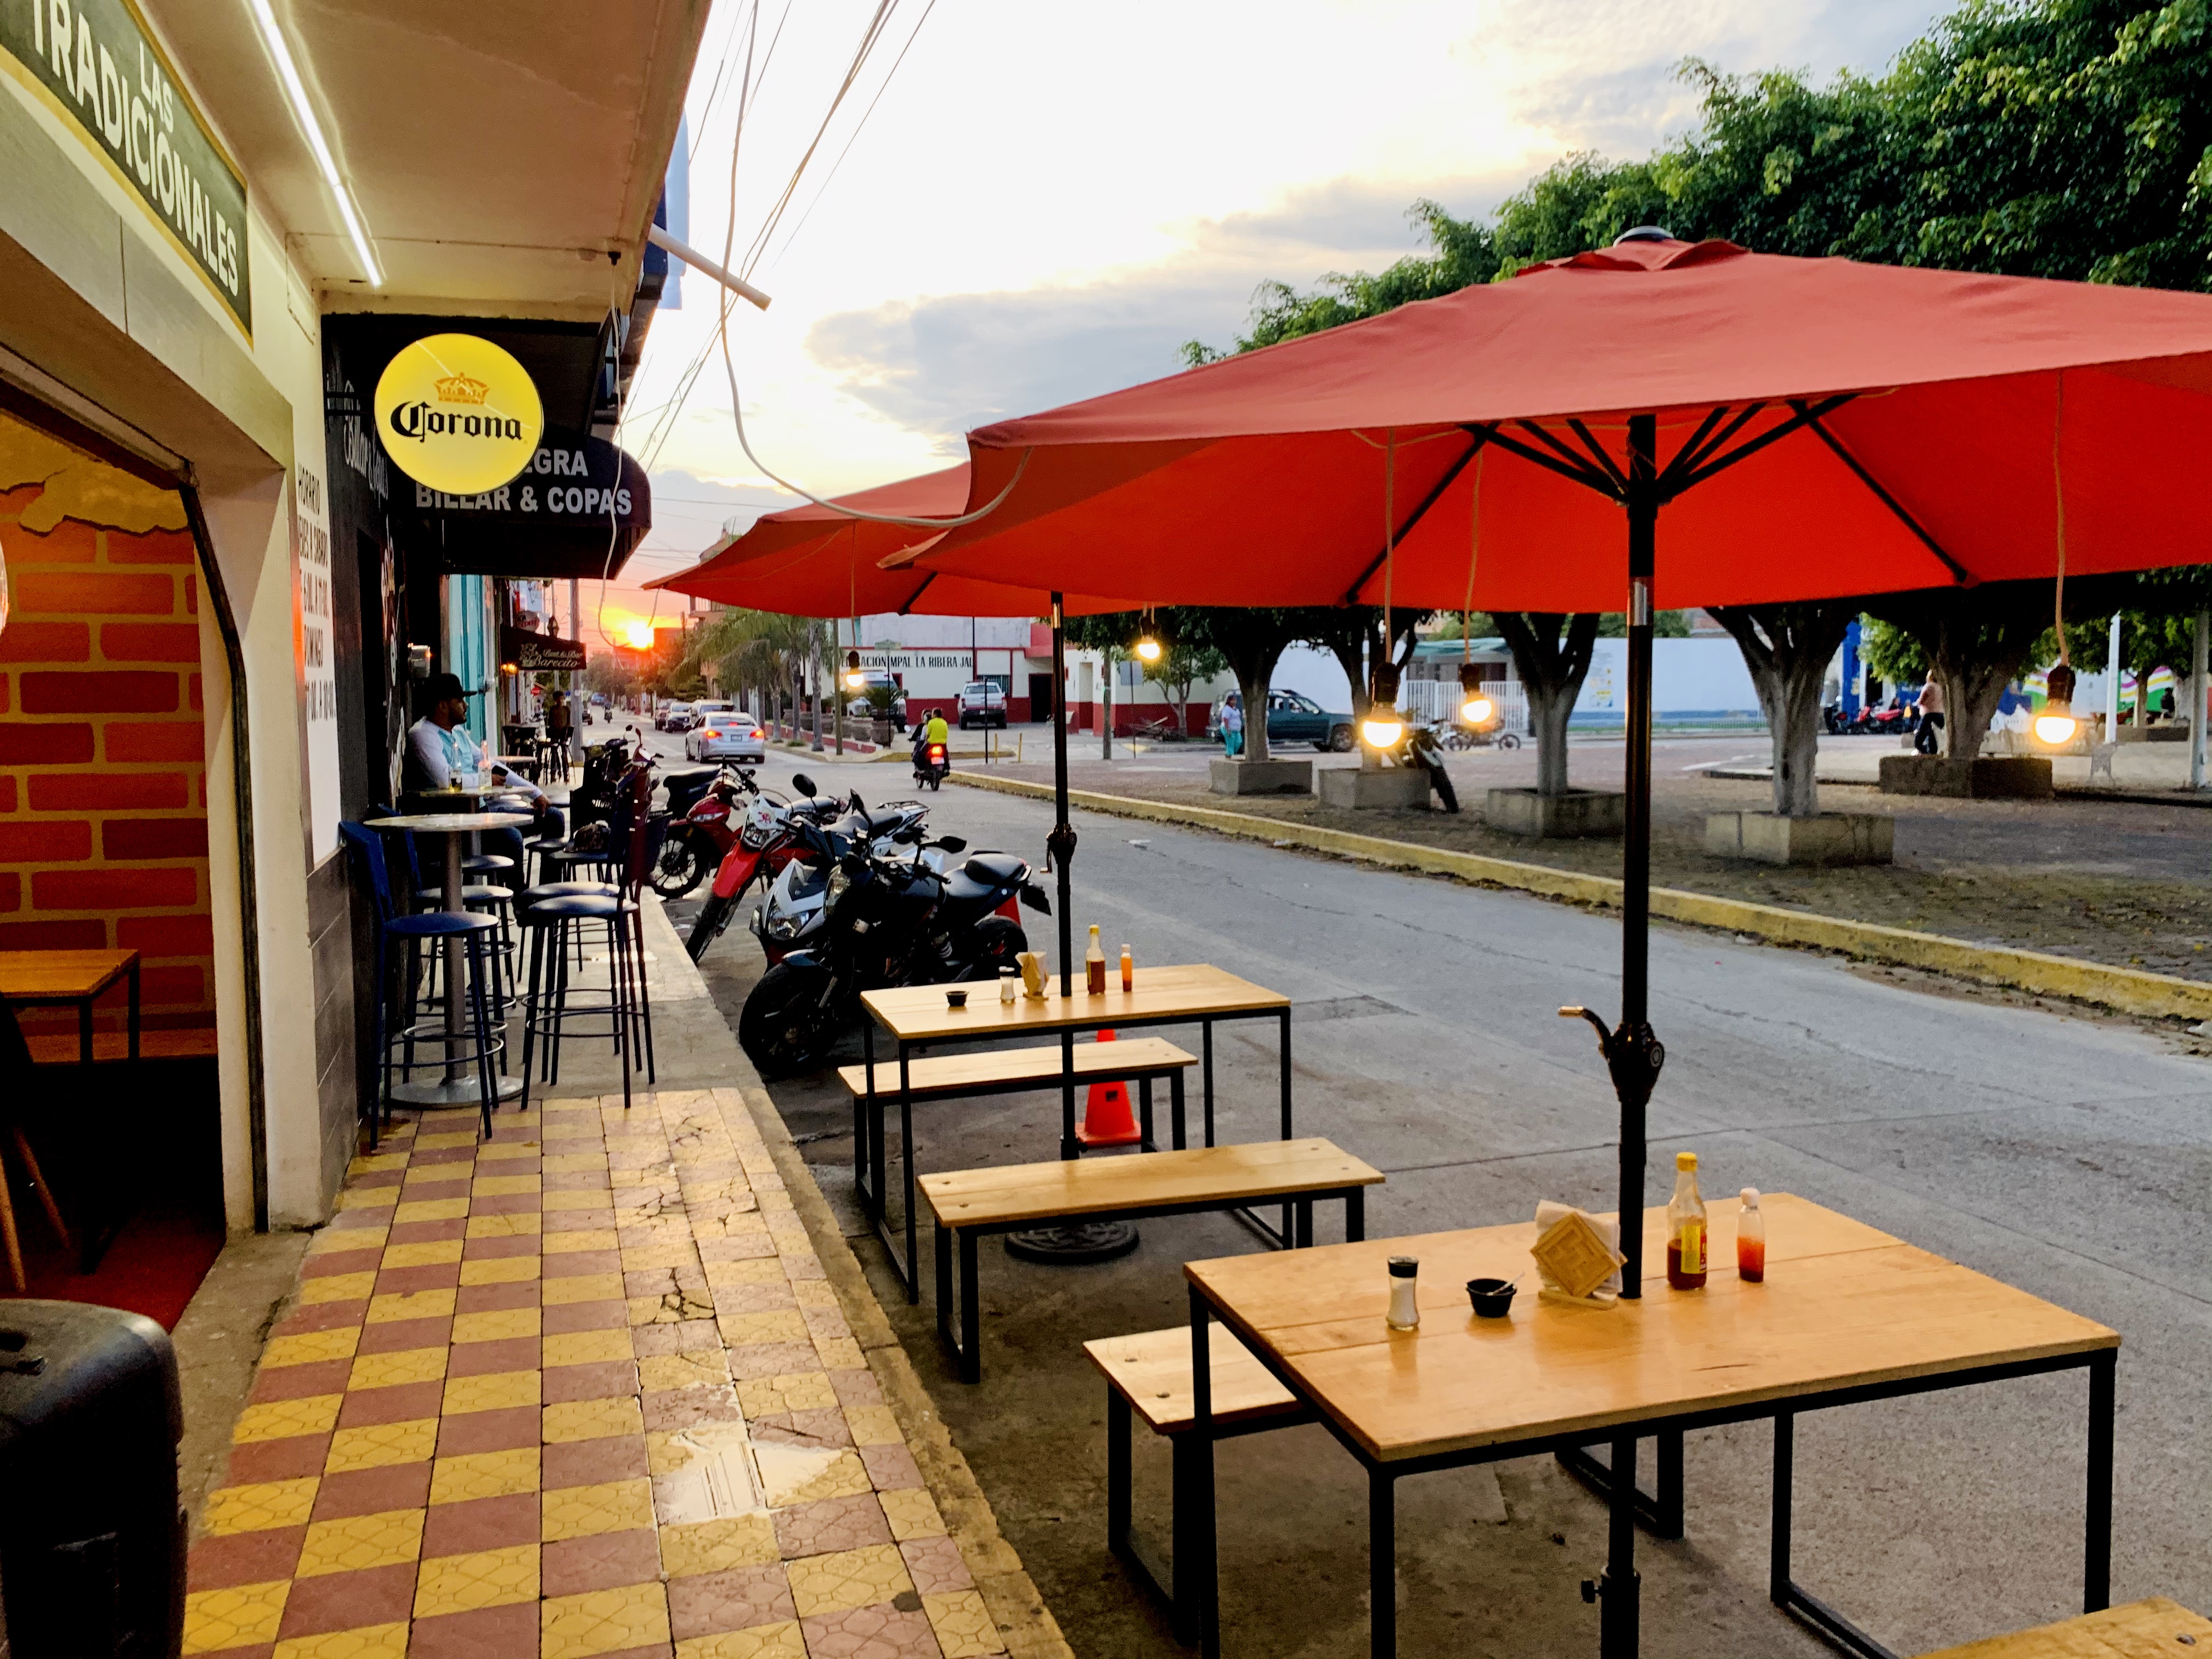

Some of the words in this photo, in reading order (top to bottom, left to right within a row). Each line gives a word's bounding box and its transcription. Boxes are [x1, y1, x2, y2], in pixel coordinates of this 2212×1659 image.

[139, 40, 174, 133] LAS
[390, 401, 522, 443] Corona
[524, 448, 589, 477] GRA
[298, 462, 320, 516] HORARIO
[415, 482, 511, 511] BILLAR
[520, 486, 538, 512] &
[548, 487, 632, 515] COPAS
[916, 656, 926, 668] LA
[929, 656, 958, 668] RIBERA
